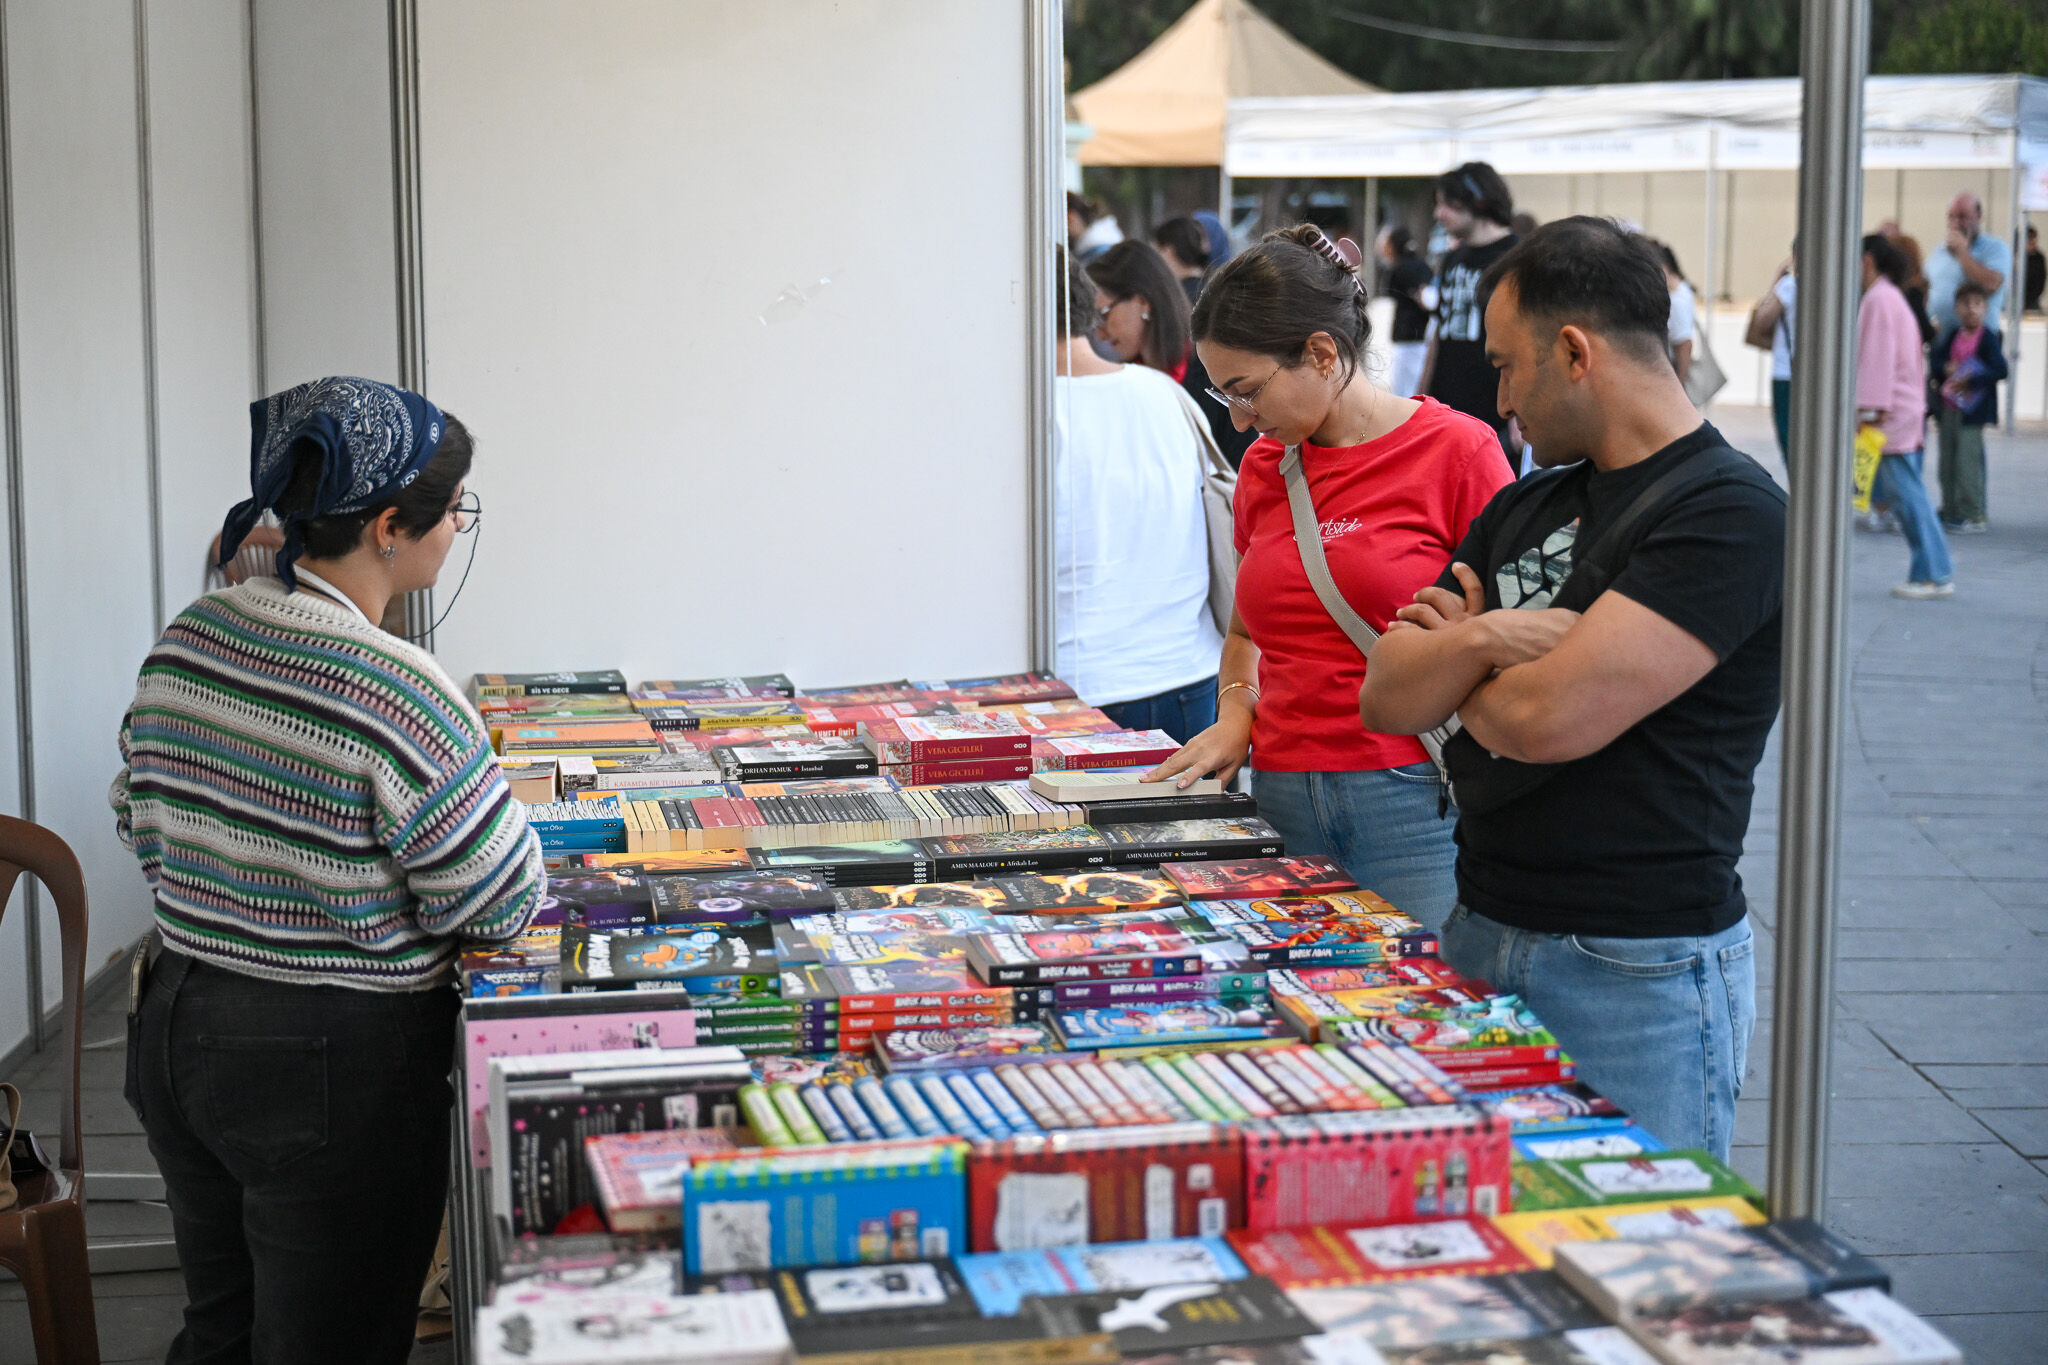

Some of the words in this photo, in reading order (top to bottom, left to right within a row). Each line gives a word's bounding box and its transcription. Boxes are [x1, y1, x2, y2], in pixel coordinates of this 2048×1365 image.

[927, 747, 946, 755] VEBA
[947, 744, 983, 754] GECELERİ
[1081, 760, 1102, 769] VEBA
[1102, 757, 1136, 767] GECELERİ
[928, 769, 948, 778] VEBA
